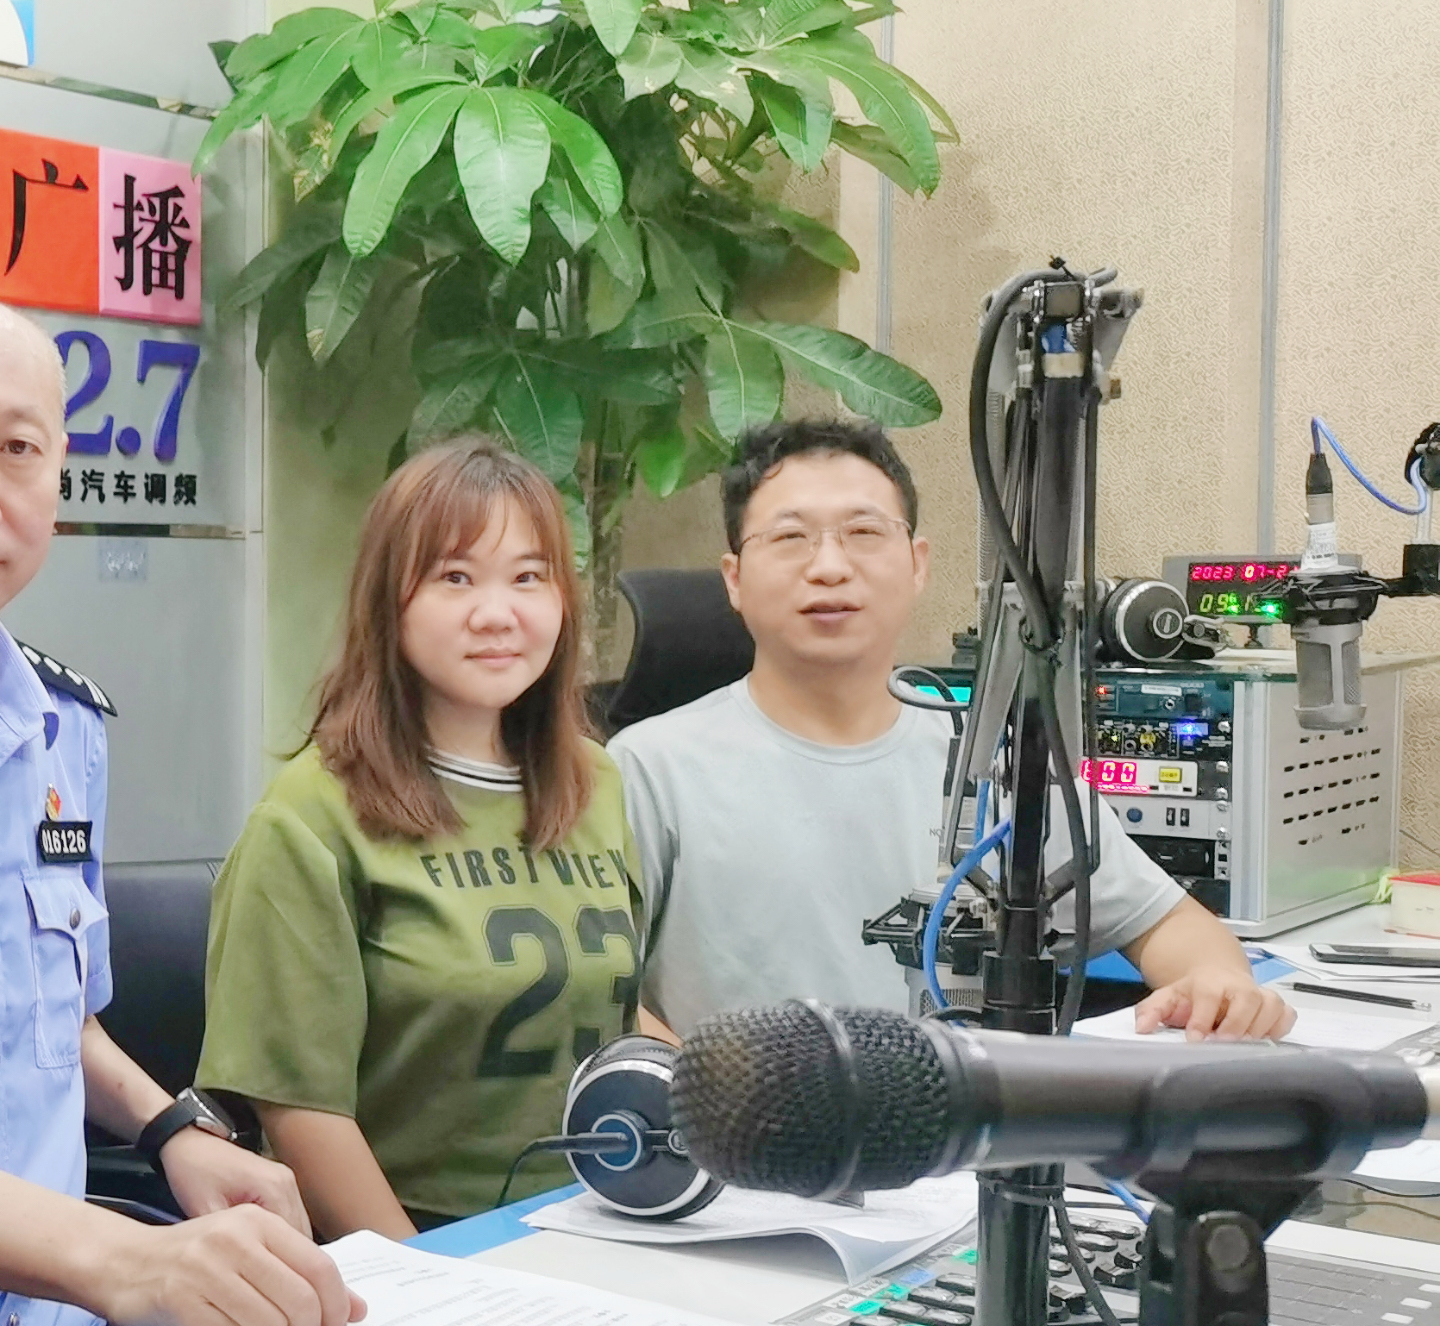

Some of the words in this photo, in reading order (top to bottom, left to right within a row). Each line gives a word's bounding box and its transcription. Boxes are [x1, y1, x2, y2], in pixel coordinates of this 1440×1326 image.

[1191, 565, 1235, 581] 2023
[41, 829, 87, 854] 016126
[419, 847, 540, 889] FIRST
[475, 903, 641, 1078] 23
